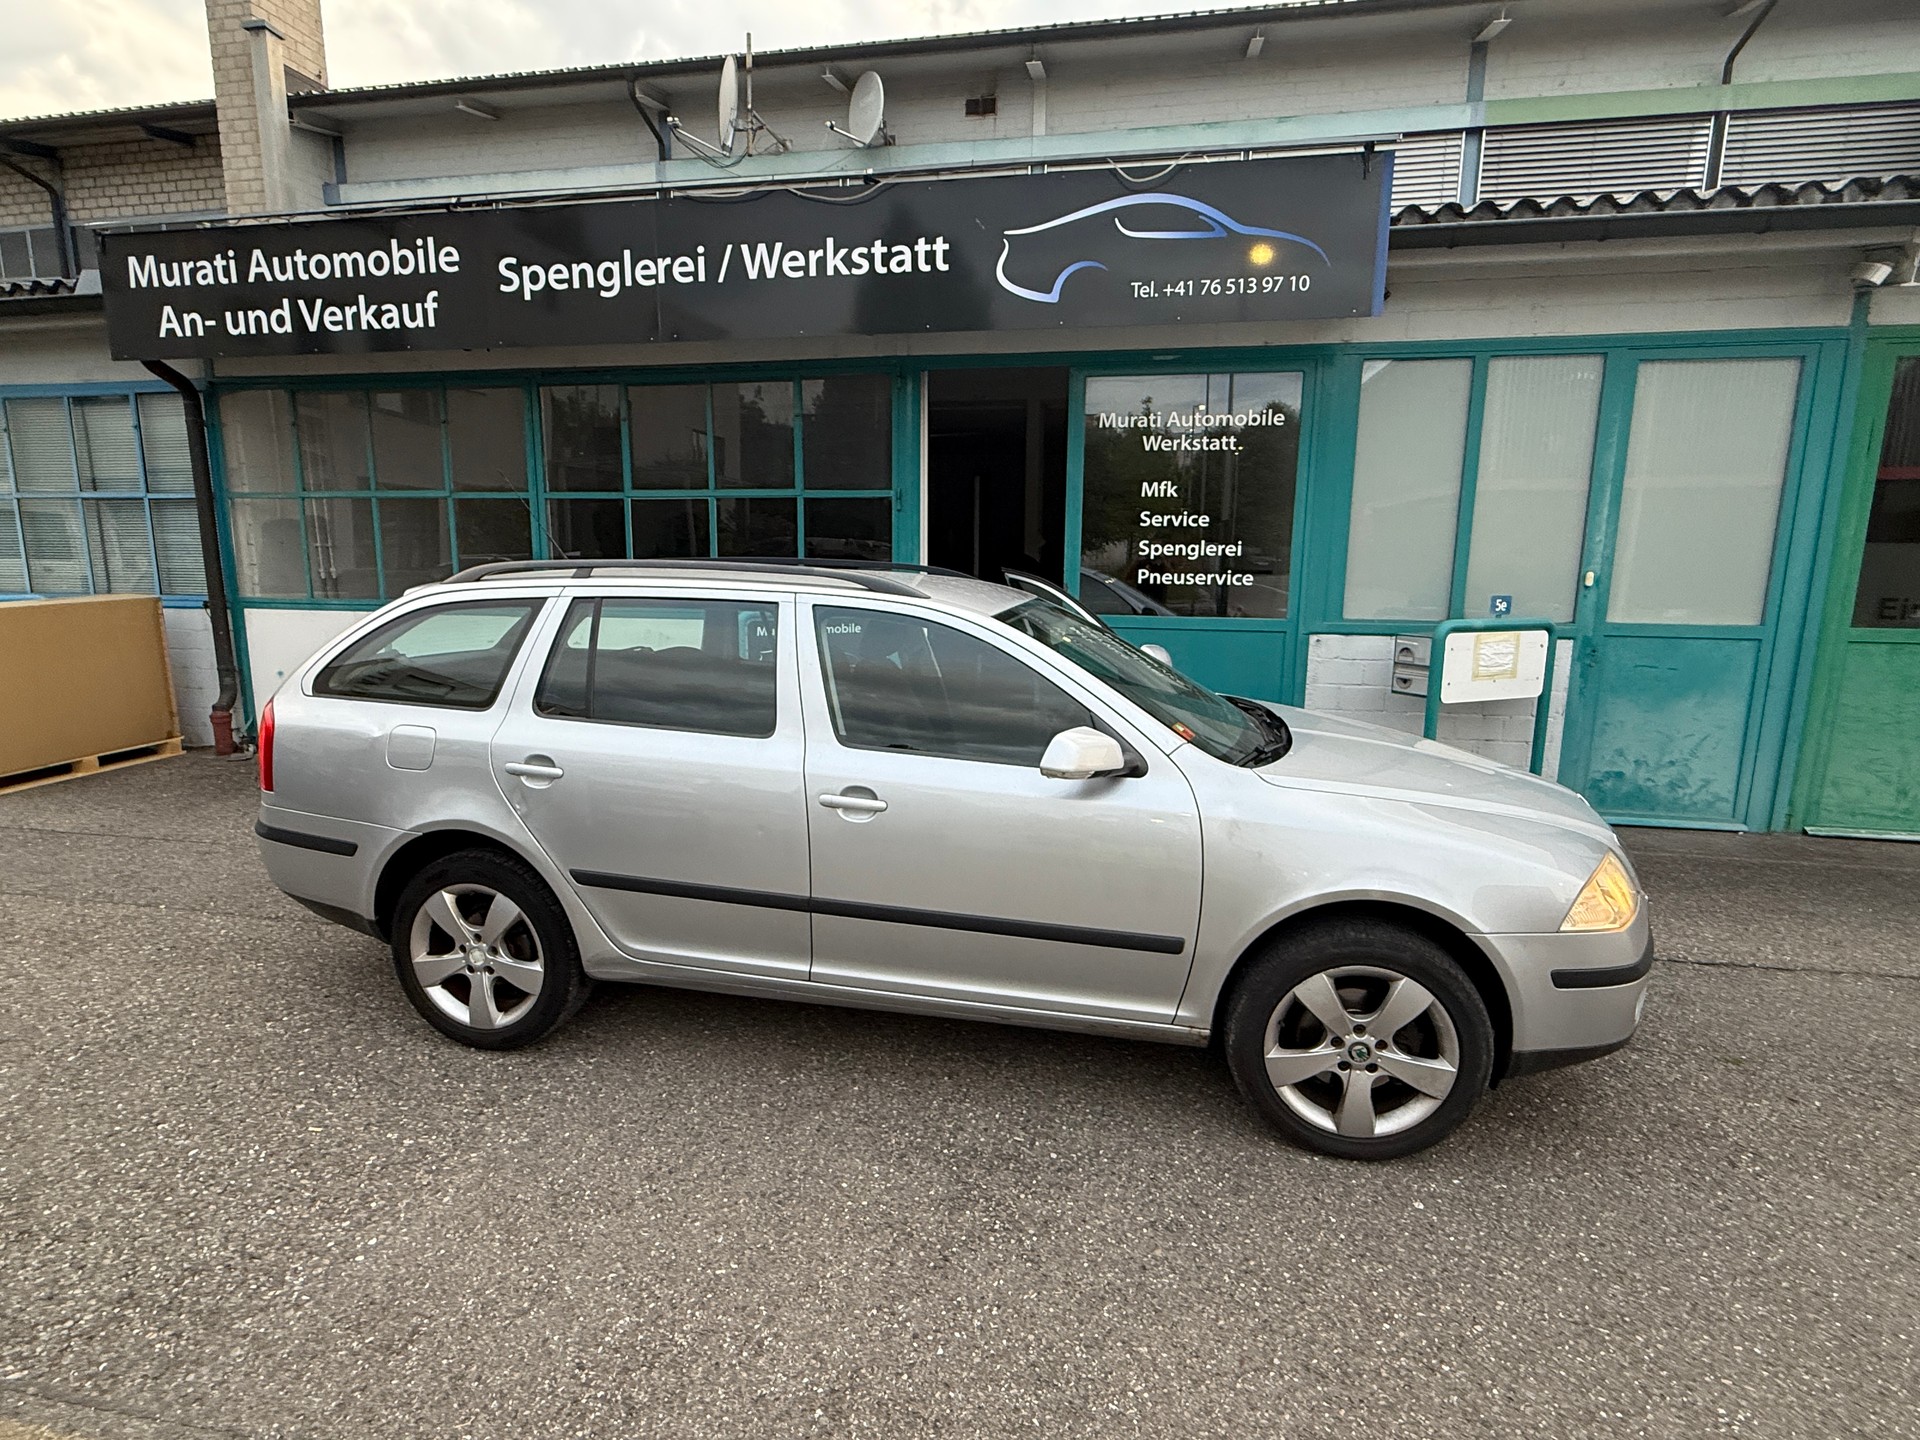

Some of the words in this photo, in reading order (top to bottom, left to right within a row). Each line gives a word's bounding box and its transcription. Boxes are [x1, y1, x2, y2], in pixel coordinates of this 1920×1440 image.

[127, 249, 238, 289] Murati
[247, 236, 460, 283] Automobile
[498, 245, 706, 301] Spenglerei
[717, 244, 733, 283] /
[740, 235, 950, 280] Werkstatt
[1130, 280, 1159, 298] Tel.
[1162, 280, 1193, 297] +41
[1200, 278, 1222, 296] 76
[1225, 277, 1257, 295] 513
[1261, 276, 1284, 293] 97
[1289, 274, 1311, 292] 10
[159, 305, 216, 338] An-
[224, 298, 293, 336] und
[297, 290, 439, 332] Verkauf
[1099, 411, 1162, 428] Murati
[1166, 409, 1285, 428] Automobile
[1142, 434, 1237, 451] Werkstatt
[1141, 480, 1178, 498] Mfk
[1139, 510, 1210, 527] Service
[1138, 540, 1243, 560] Spenglerei
[1137, 568, 1254, 586] Pneuservice
[1495, 598, 1508, 612] 5e
